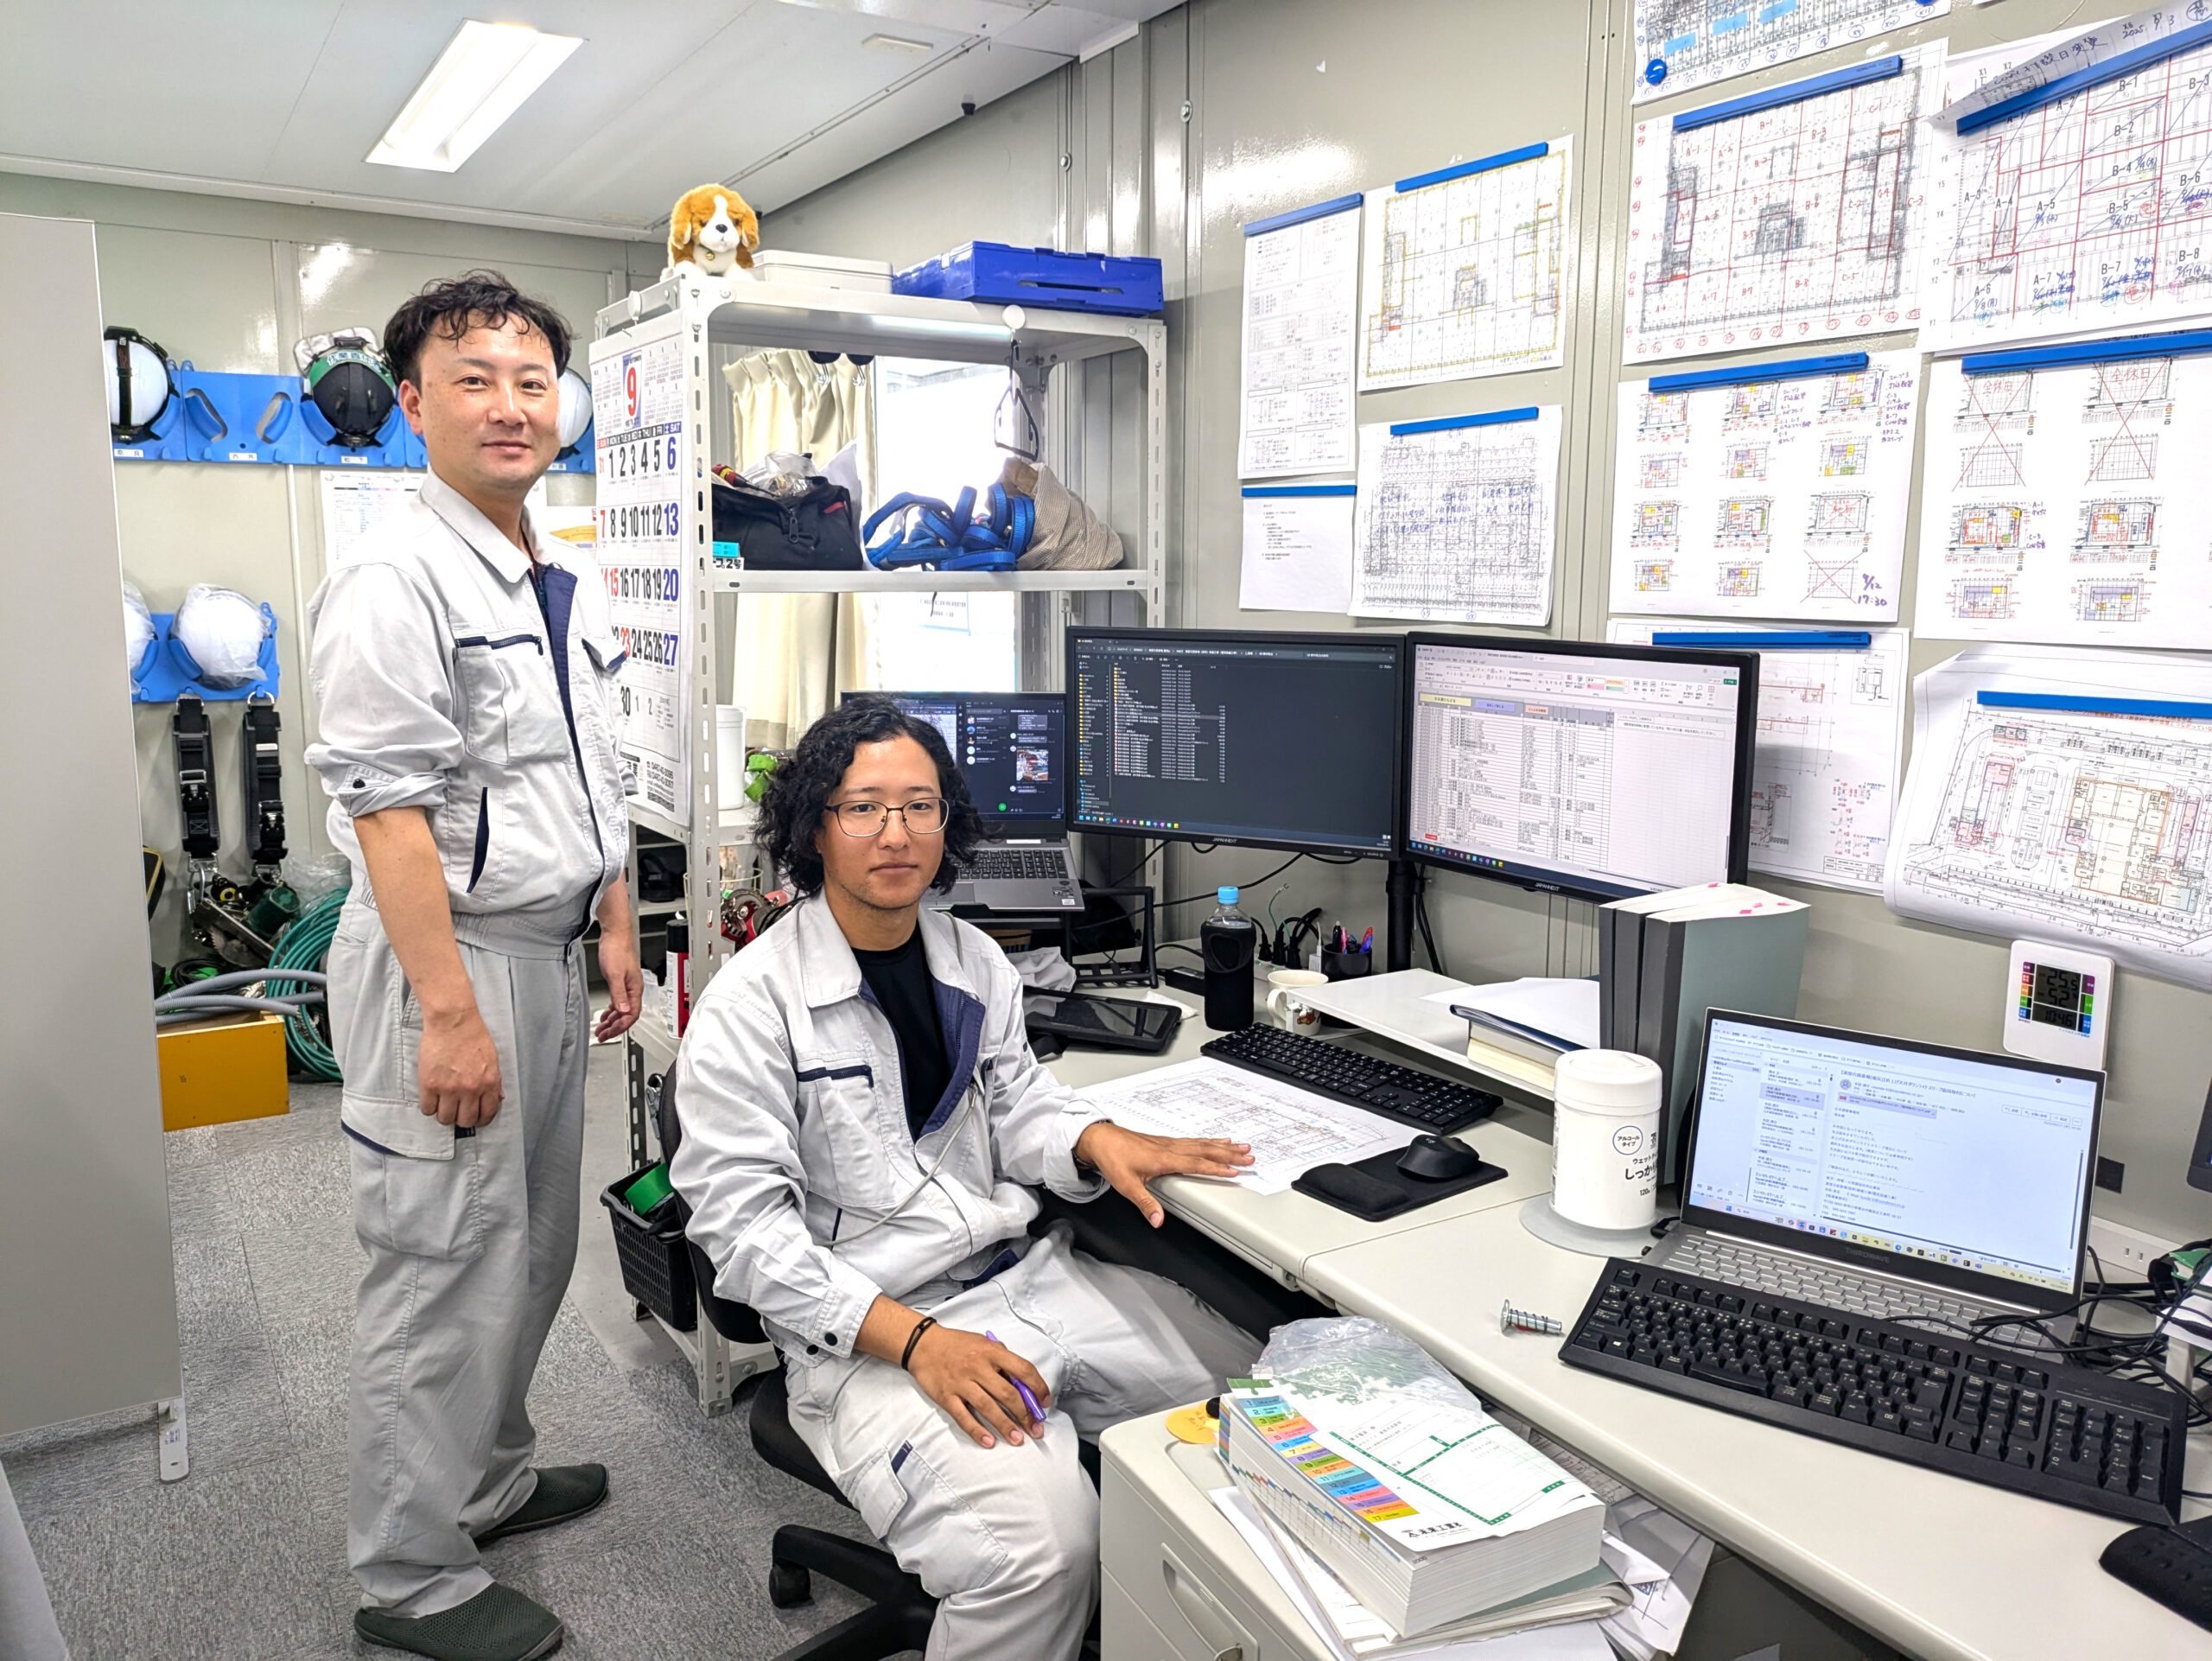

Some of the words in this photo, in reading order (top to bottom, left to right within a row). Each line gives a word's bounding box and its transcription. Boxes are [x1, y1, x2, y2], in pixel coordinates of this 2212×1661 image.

[2004, 61, 2012, 70] X2
[2120, 76, 2138, 91] B-1
[2190, 73, 2209, 89] B-3
[1759, 118, 1773, 130] B-1
[2113, 122, 2134, 137] B-2
[1811, 127, 1827, 139] B-3
[2113, 162, 2131, 176] B-4
[2180, 171, 2200, 186] B-6
[1907, 195, 1923, 207] C-3
[1964, 191, 1980, 202] A-3
[1995, 196, 2012, 208] A-4
[2037, 199, 2056, 212] A-5
[2108, 200, 2128, 213] B-5
[1651, 232, 1664, 242] A-3
[2179, 248, 2200, 262] B-8
[2101, 261, 2120, 275] B-7
[1795, 278, 1809, 289] B-8
[2033, 272, 2051, 284] A-7
[1974, 283, 1991, 296] A-6
[1701, 292, 1718, 302] A-7
[2110, 367, 2151, 383] 全休日
[627, 367, 636, 416] 9
[1983, 380, 2013, 394] 全休日
[664, 425, 669, 434] 土
[671, 423, 680, 433] SAT
[609, 449, 614, 478] 1
[620, 447, 626, 477] 2
[631, 444, 636, 475] 3
[641, 442, 648, 473] 4
[654, 439, 661, 472] 5
[667, 436, 676, 470] 6
[600, 510, 605, 538] 7
[610, 508, 616, 538] 8
[621, 507, 626, 538] 9
[629, 506, 639, 537] 10
[641, 505, 649, 536] 11
[652, 504, 662, 536] 12
[664, 503, 678, 536] 13
[610, 568, 619, 597] 15
[620, 568, 629, 598] 16
[630, 568, 639, 598] 17
[642, 568, 651, 600] 18
[653, 568, 661, 601] 19
[663, 569, 678, 601] 20
[1862, 573, 1883, 591] 9/12
[1858, 595, 1887, 606] 17:30
[632, 629, 642, 659] 24
[644, 630, 653, 662] 25
[653, 632, 663, 664] 26
[664, 633, 678, 666] 27
[621, 686, 630, 716] 30
[636, 695, 639, 712] 1
[648, 698, 652, 716] 2
[2046, 969, 2078, 991] 25.5
[2049, 988, 2070, 1008] 52
[1846, 1247, 1891, 1263] THIRDWAVE
